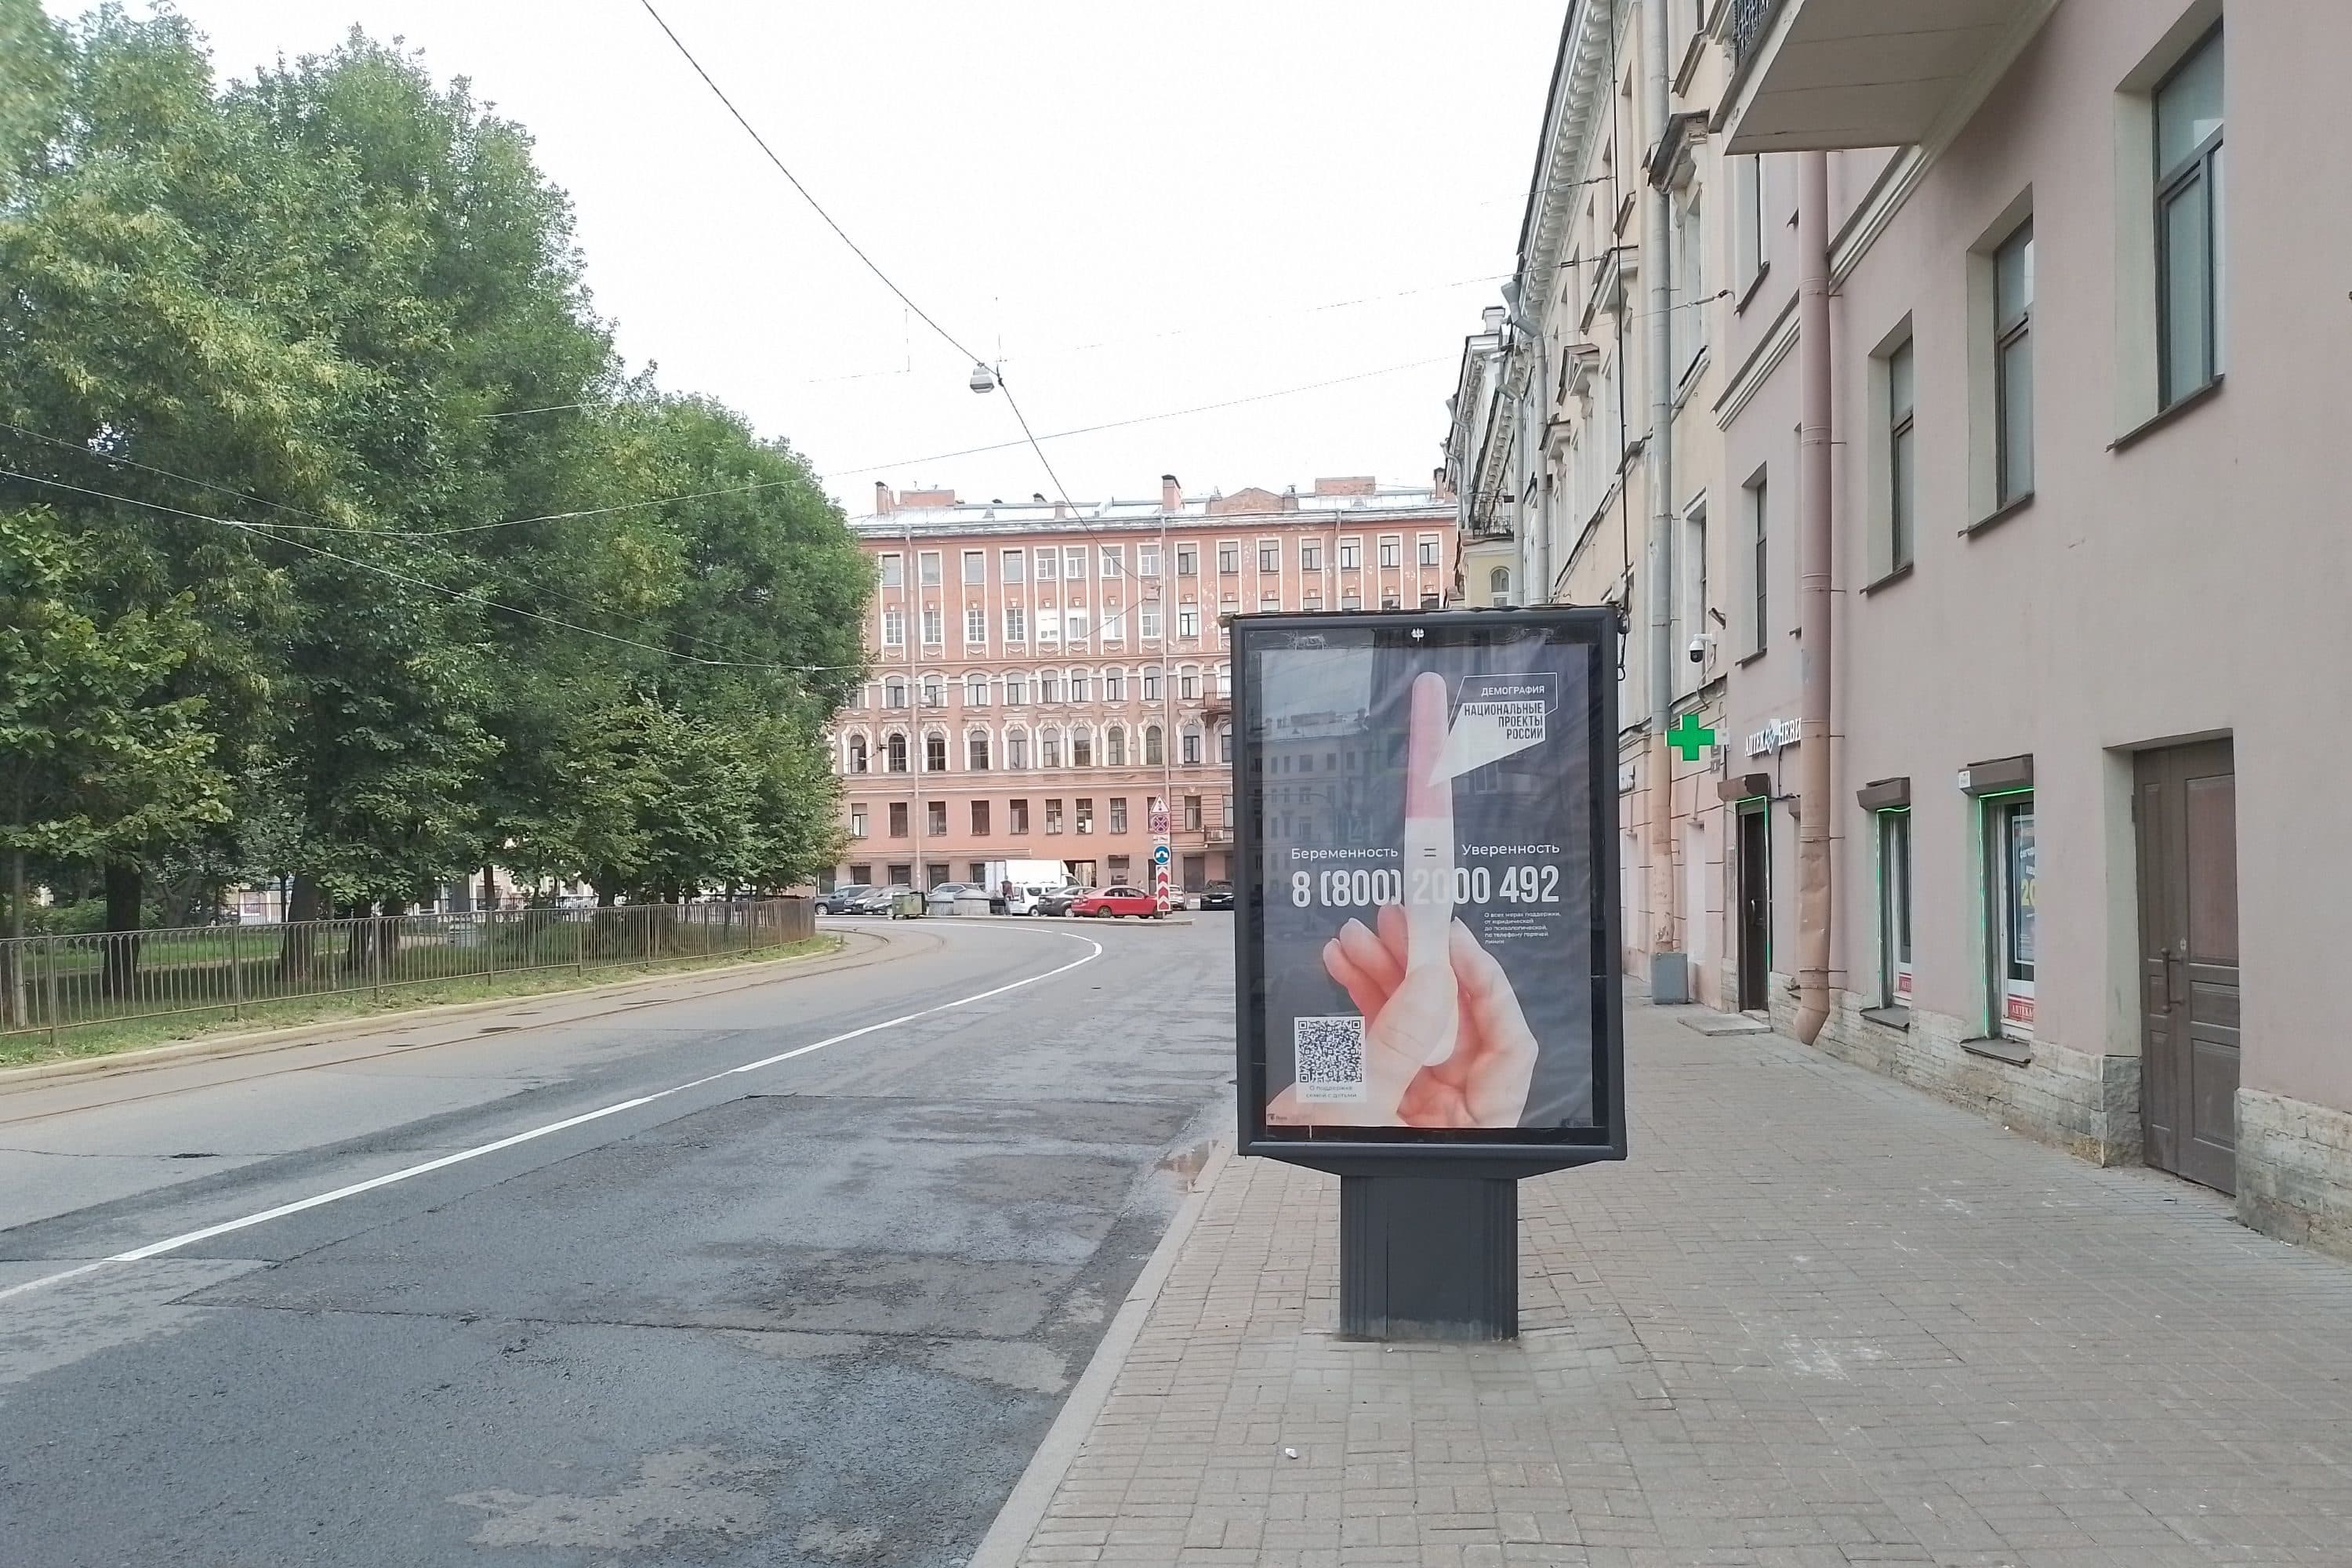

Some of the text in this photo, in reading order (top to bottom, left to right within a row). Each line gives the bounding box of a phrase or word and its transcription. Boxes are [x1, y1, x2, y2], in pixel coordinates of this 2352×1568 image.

[1481, 685, 1545, 697] ДЕМОГРАФИЯ
[1464, 702, 1543, 717] НАЦИОНАЛЬНЫЕ
[1498, 715, 1543, 728] ПРОЕКТЫ
[1506, 727, 1544, 740] РОССИИ
[1291, 848, 1399, 862] Беременность
[1461, 843, 1560, 858] Уверенность
[1292, 865, 1559, 908] 8 (800) 2000 492
